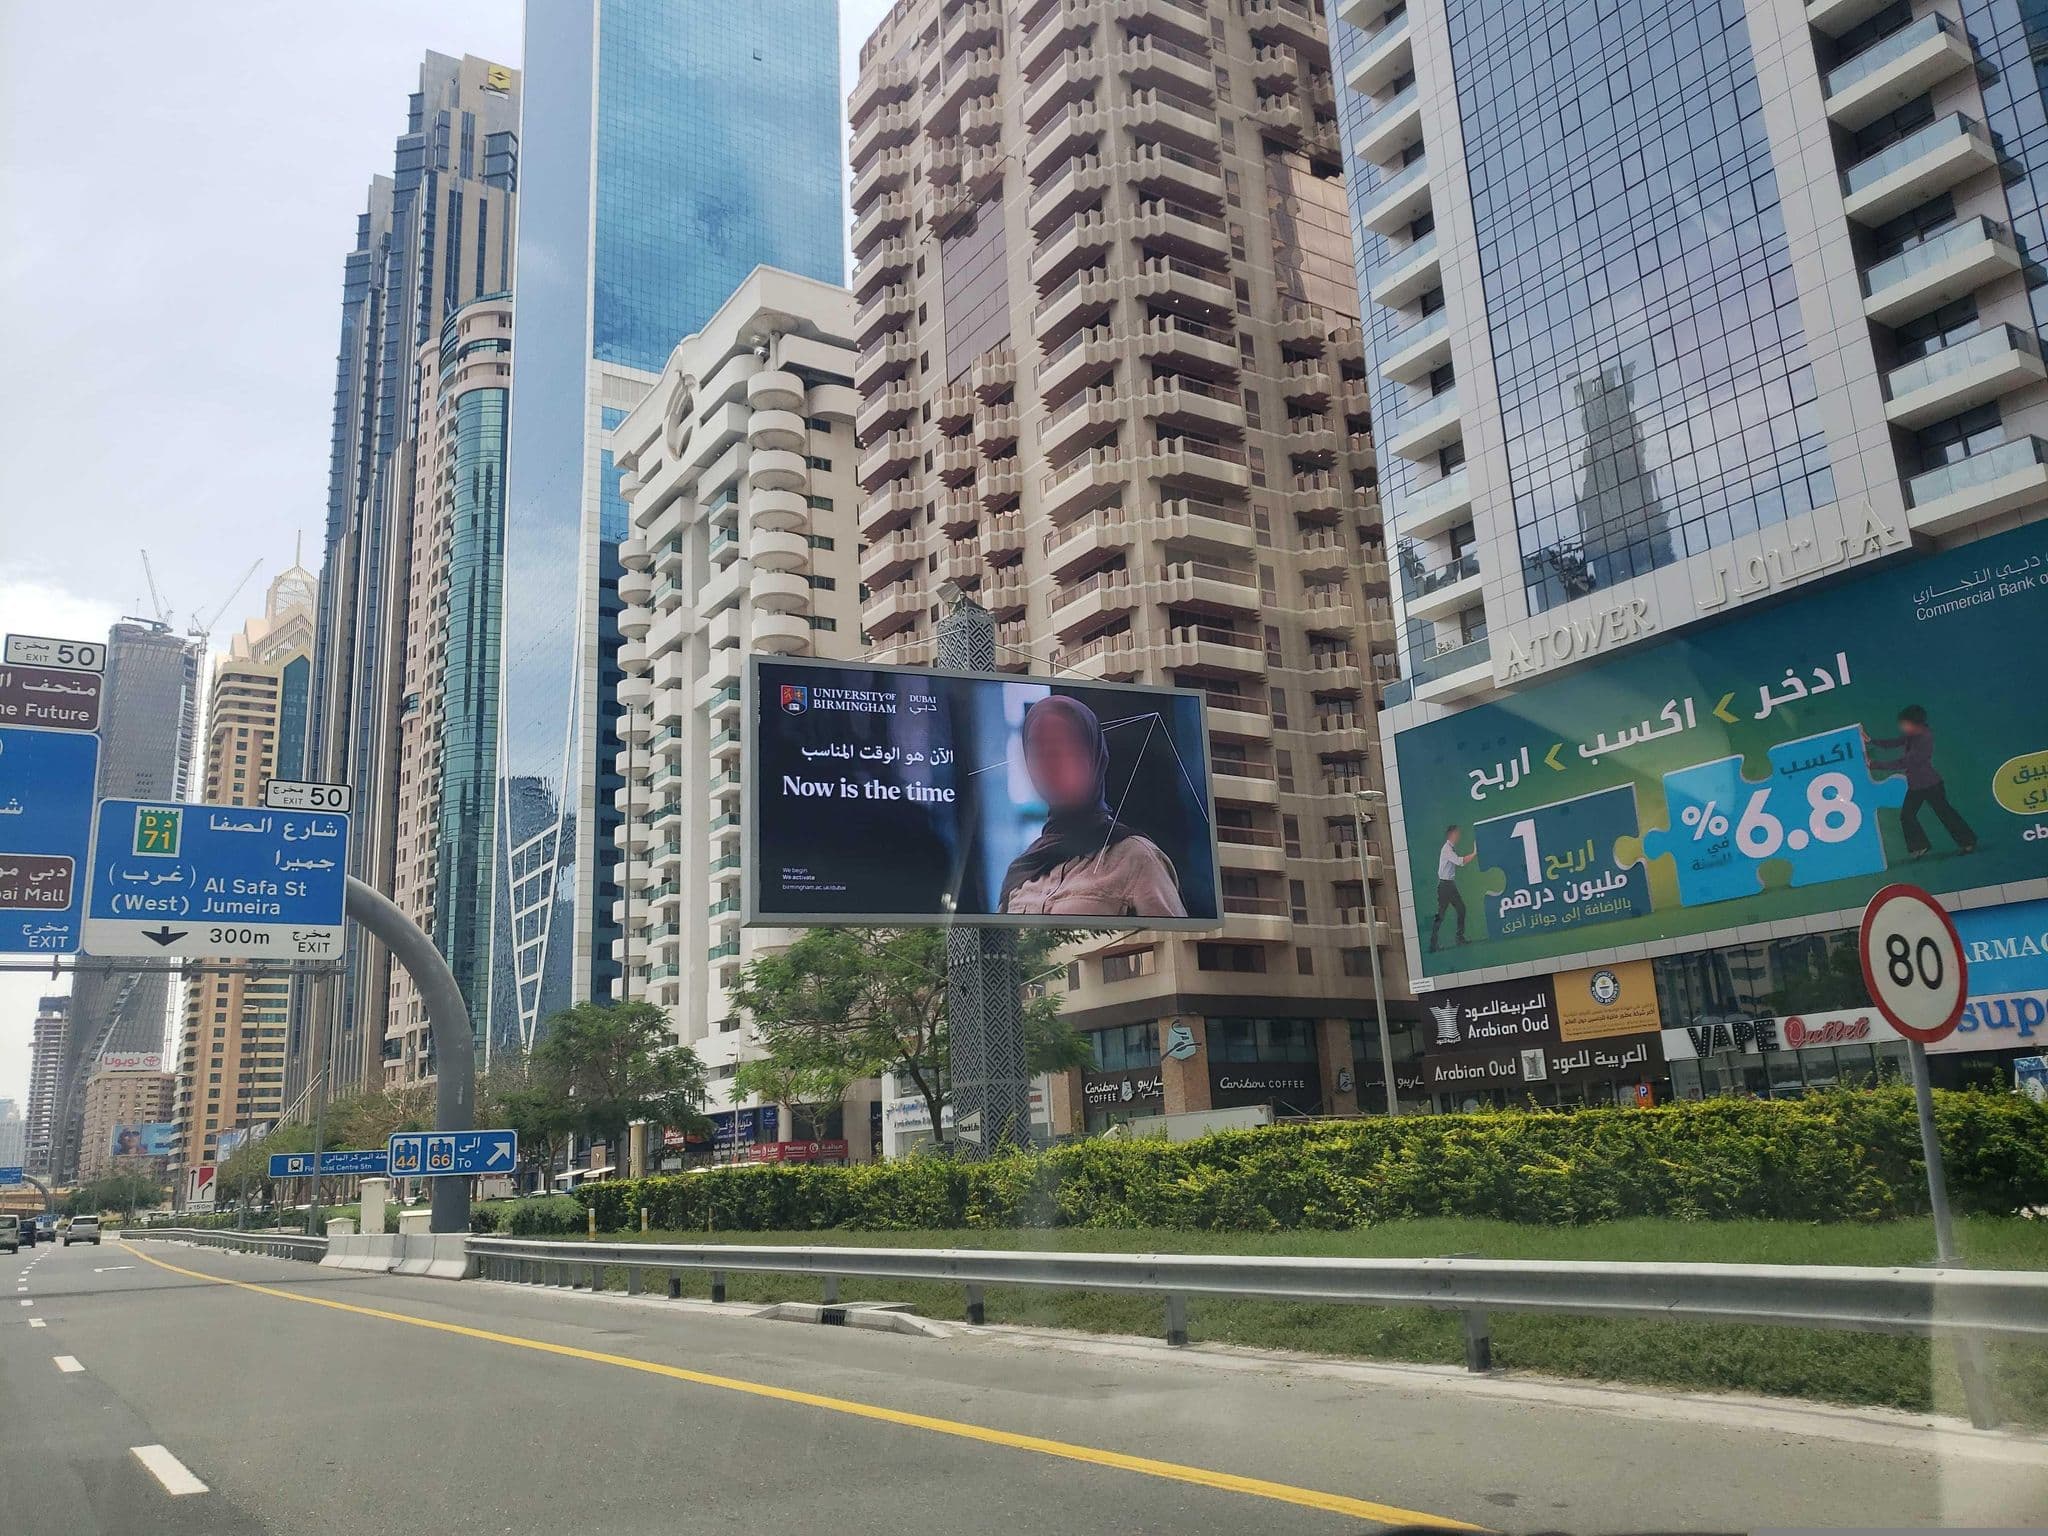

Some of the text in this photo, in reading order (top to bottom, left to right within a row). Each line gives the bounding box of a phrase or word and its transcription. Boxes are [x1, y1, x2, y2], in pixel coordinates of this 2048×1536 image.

[1916, 587, 1996, 621] Commercial
[1998, 575, 2036, 597] Bank
[14, 641, 50, 651] مخرج
[57, 644, 95, 666] 50
[26, 653, 49, 662] EXIT
[22, 678, 97, 697] متحف
[813, 687, 886, 702] UNIVERSITY
[813, 699, 897, 714] BIRMINGHAM
[909, 694, 937, 704] DUBAI
[25, 703, 90, 721] Future
[909, 704, 938, 716] دبي
[1468, 652, 1851, 801] ادخر اكسب اربح
[801, 743, 954, 766] الآن هو الوقت المناسب
[1780, 742, 1854, 779] اكسب
[273, 786, 304, 795] مخرج
[310, 787, 343, 808] 50
[783, 775, 956, 803] Now is the time
[283, 797, 304, 806] EXIT
[145, 816, 157, 827] D
[209, 814, 338, 842] شارع الصفا
[143, 830, 170, 849] 71
[274, 849, 336, 873] جميرا
[1510, 818, 1542, 885] 1
[1545, 839, 1595, 880] اربح
[29, 866, 67, 886] دبي
[25, 888, 65, 902] Mall
[203, 878, 307, 898] Al Safa St
[1499, 870, 1629, 919] مليون درهم
[111, 893, 190, 916] (West)
[202, 897, 281, 916] Jumeira
[22, 922, 69, 936] مخرج
[209, 928, 270, 945] 300m
[292, 930, 331, 942] مخرج
[28, 936, 69, 948] EXIT
[298, 942, 330, 953] EXIT
[1886, 933, 1943, 990] 80
[1464, 1000, 1500, 1021] للعود
[1500, 993, 1546, 1015] العربية
[1468, 1021, 1518, 1039] Arabian
[1522, 1013, 1550, 1033] Oud
[1957, 997, 2048, 1038] sup
[1686, 1019, 1780, 1057] VAPE
[1784, 1016, 1871, 1048] Outlet
[1552, 1043, 1648, 1075] العربية للعود
[1434, 1057, 1517, 1081] Arabian Oud
[1085, 1081, 1120, 1094] Caribou
[1219, 1077, 1305, 1089] Caribou COFFEE
[1088, 1093, 1117, 1104] COFFEE
[459, 1137, 481, 1154] إلى
[304, 1162, 373, 1172] Finncial Centre Stn
[396, 1156, 417, 1168] 44
[432, 1154, 450, 1167] 66
[457, 1158, 473, 1169] To
